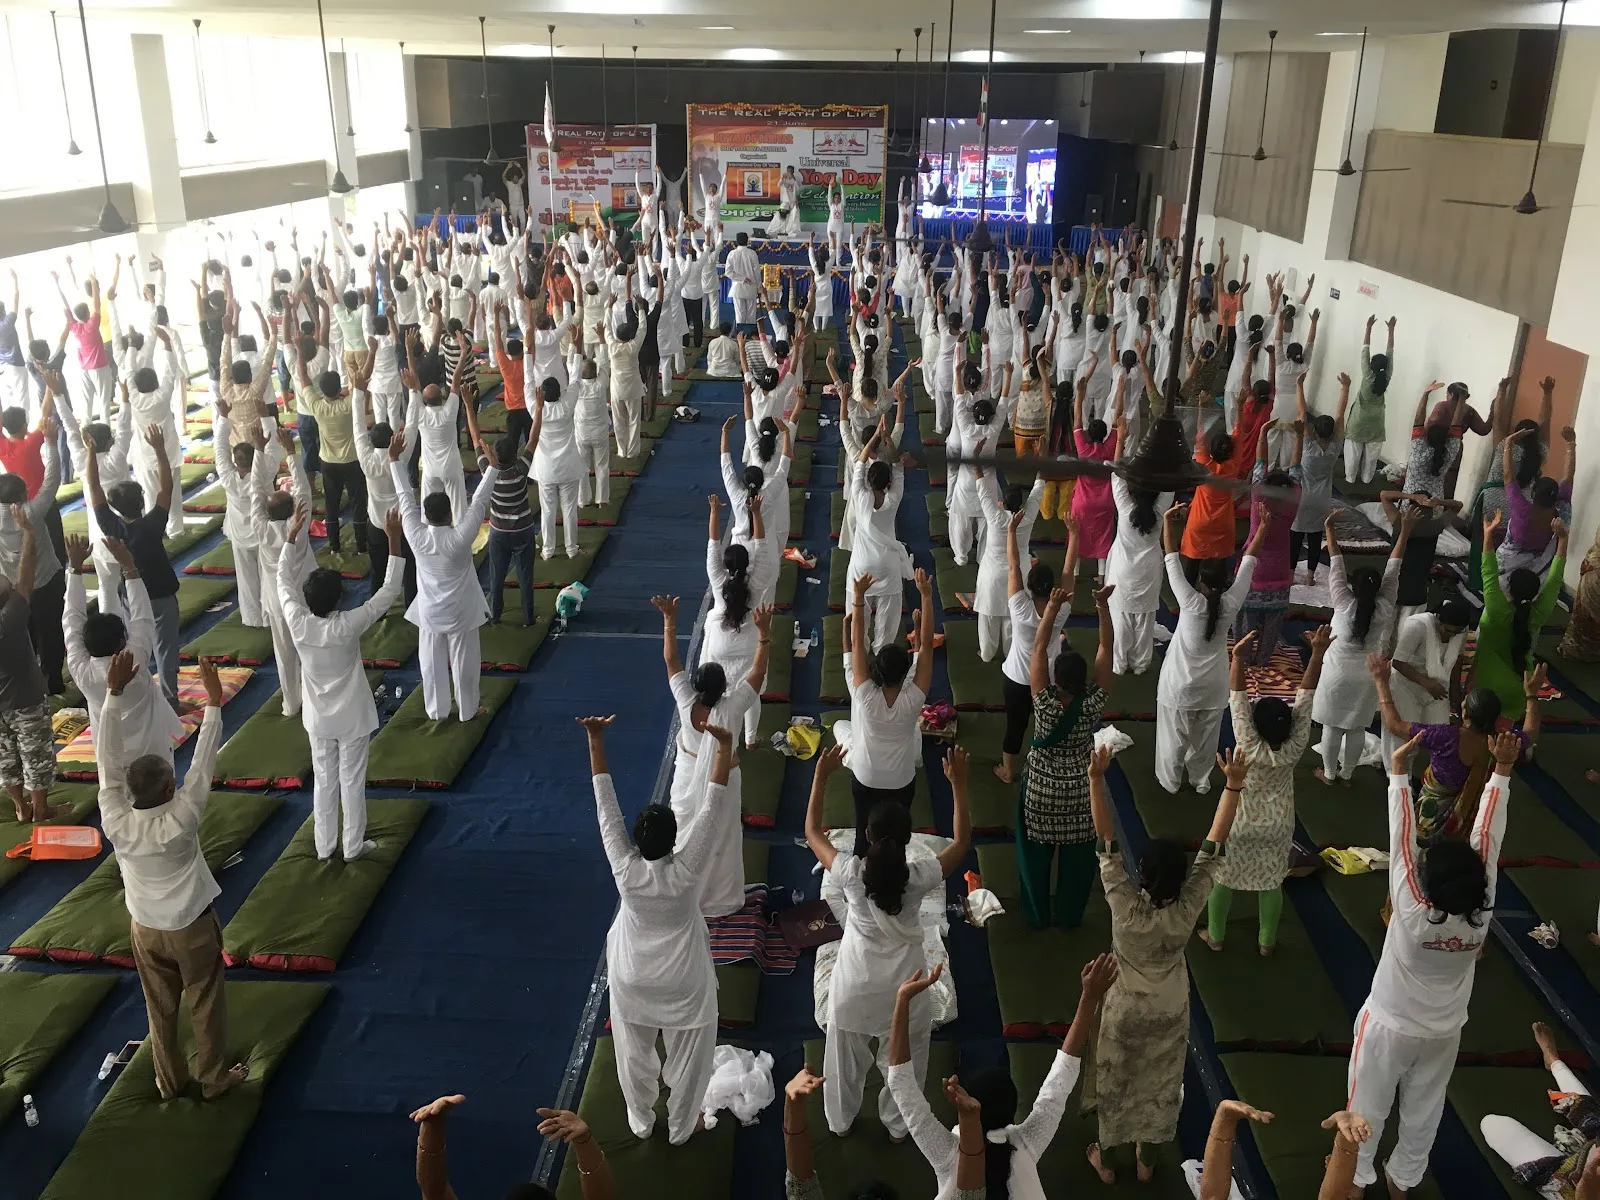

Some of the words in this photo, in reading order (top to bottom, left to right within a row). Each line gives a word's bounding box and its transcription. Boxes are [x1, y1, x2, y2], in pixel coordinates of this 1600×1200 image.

[778, 110, 815, 118] PATH
[799, 156, 851, 168] Universal
[798, 168, 838, 188] Yog
[841, 168, 882, 190] Day
